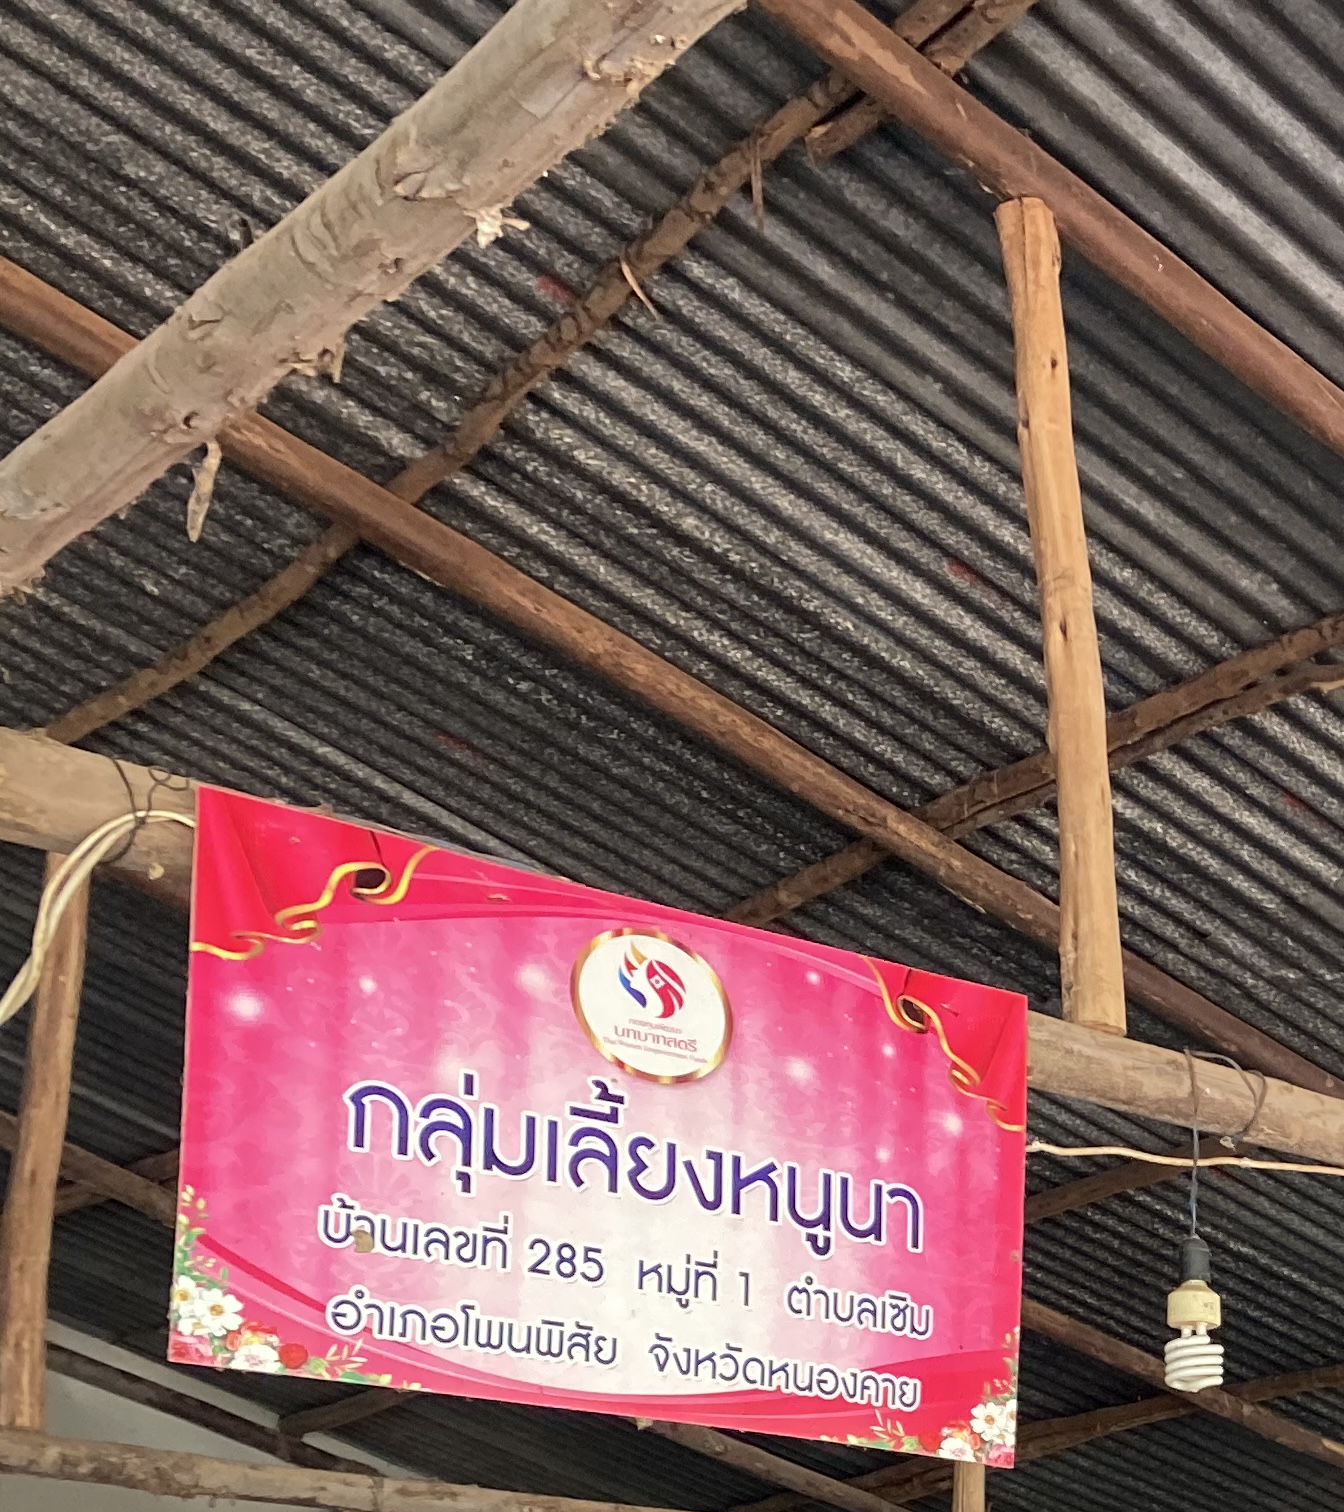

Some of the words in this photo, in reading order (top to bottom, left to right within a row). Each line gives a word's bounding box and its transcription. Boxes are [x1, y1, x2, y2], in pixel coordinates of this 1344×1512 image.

[348, 1072, 921, 1257] กลุ่มเลี้ยงหนูนา
[322, 1196, 509, 1270] บ้านเลขที่
[527, 1238, 605, 1283] 285
[637, 1249, 719, 1310] หมู่ที่
[737, 1271, 750, 1307] 1
[786, 1275, 932, 1337] ตำบลเซิม
[330, 1288, 618, 1366] อำเภอโพนพิสัย
[647, 1332, 919, 1409] จังหวัดหนองคาย
